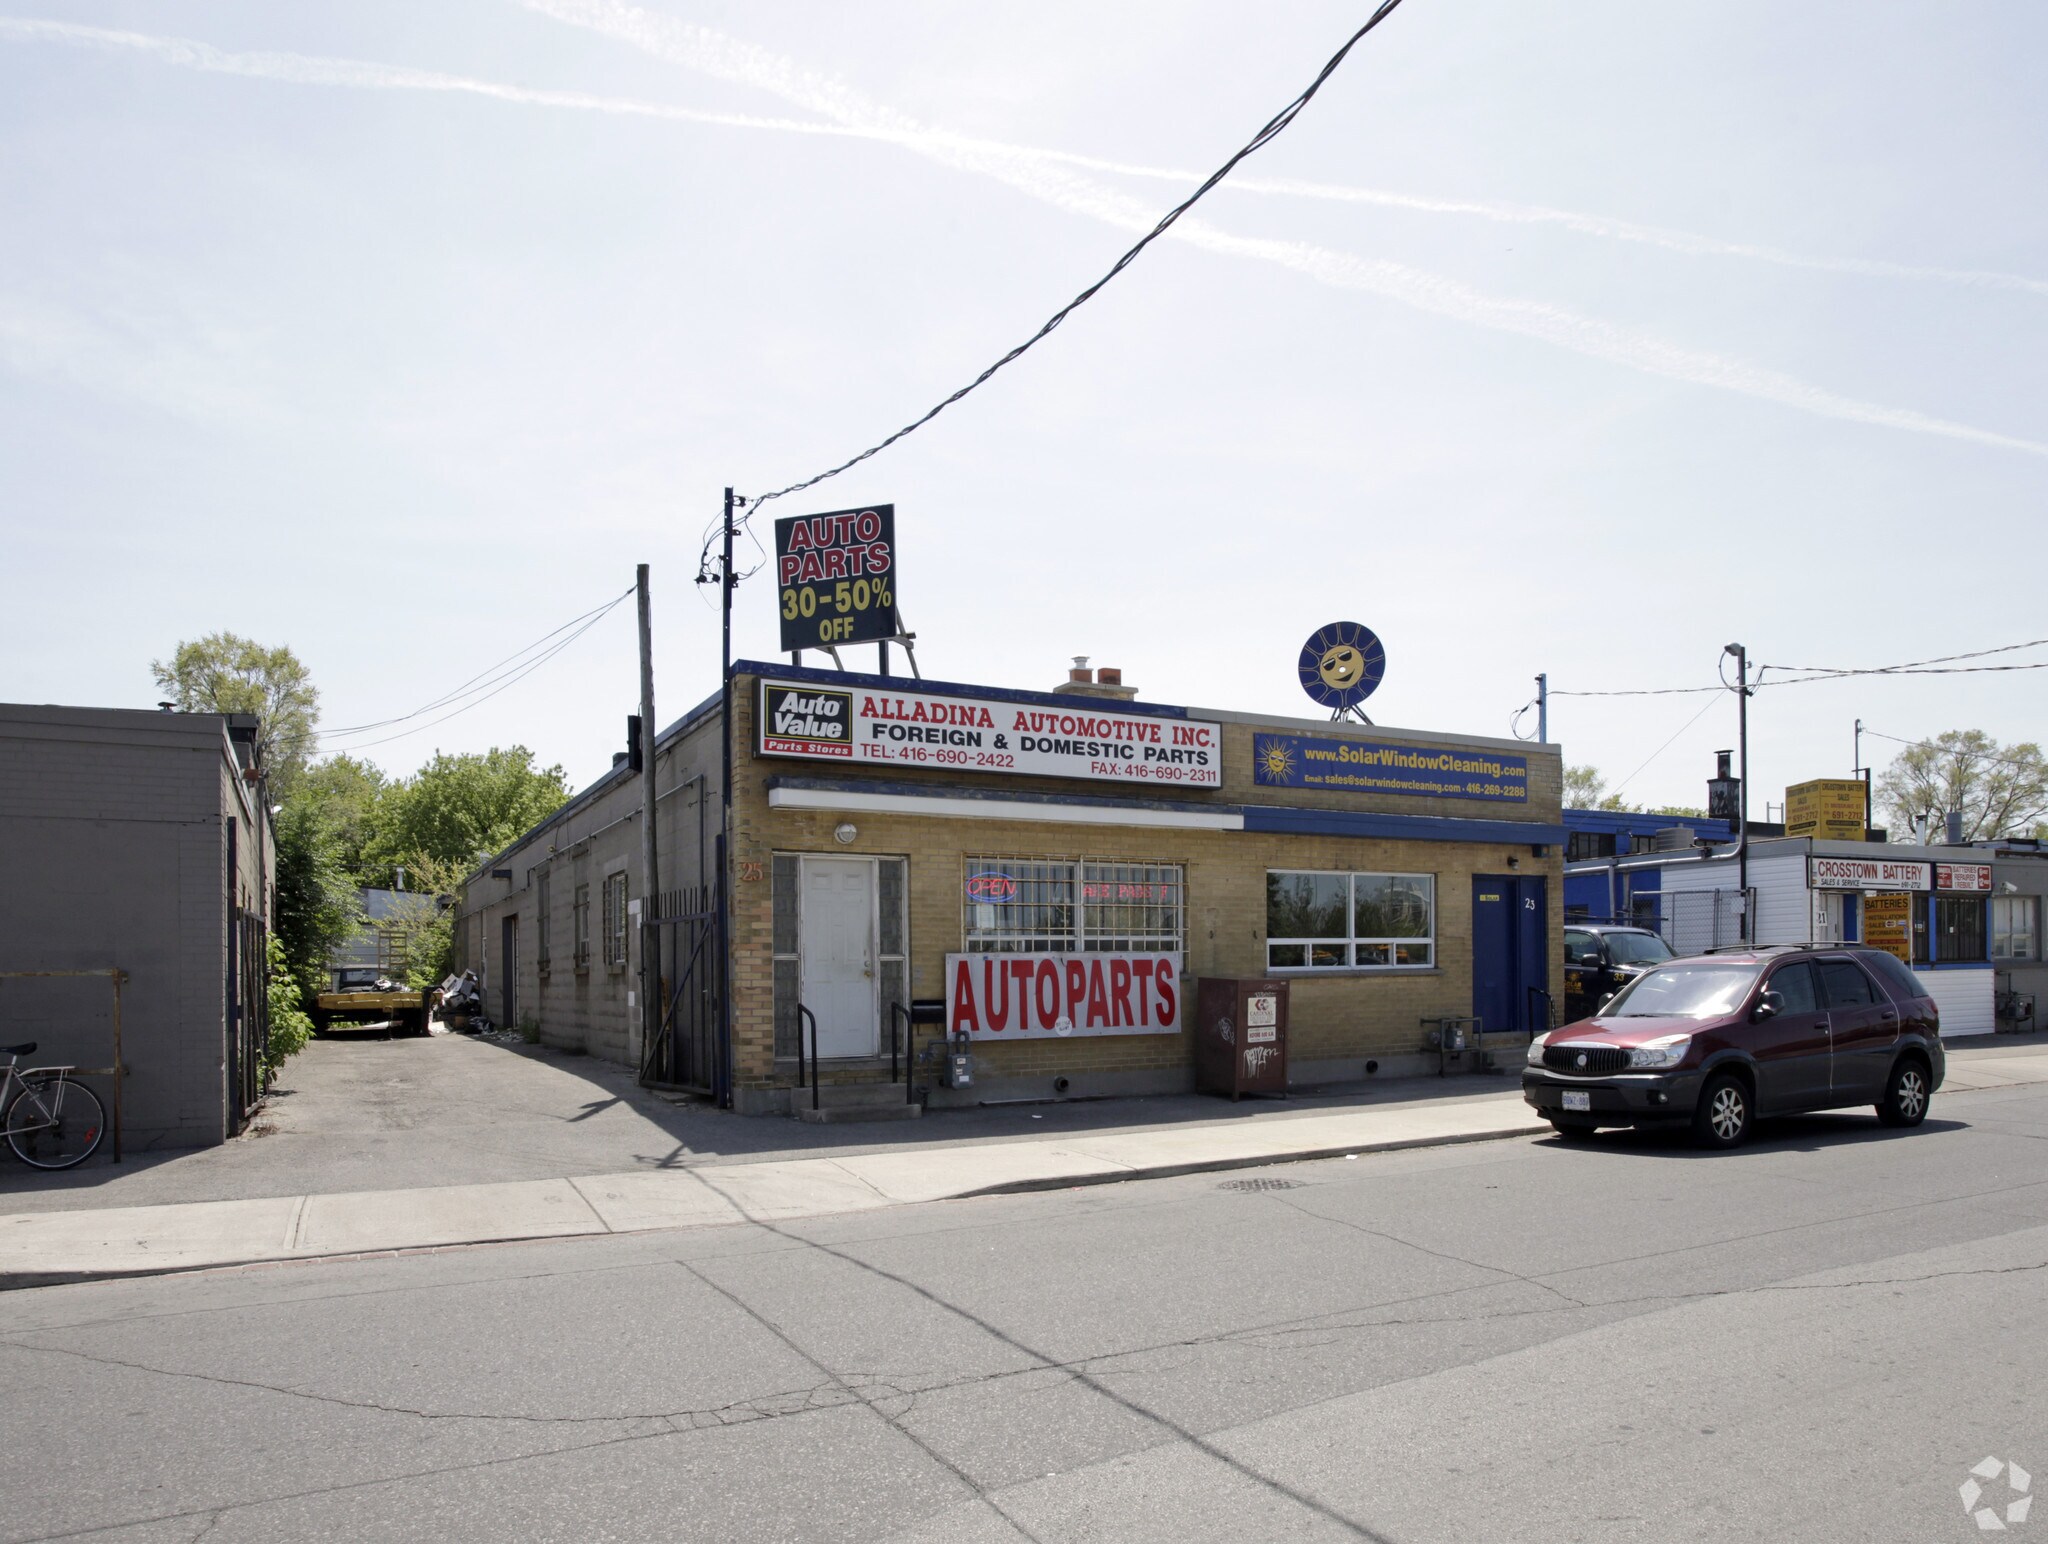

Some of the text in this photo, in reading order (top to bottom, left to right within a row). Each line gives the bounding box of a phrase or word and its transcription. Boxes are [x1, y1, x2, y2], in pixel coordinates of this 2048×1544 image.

[788, 511, 881, 552] AUTO
[780, 542, 890, 586] PARTS
[783, 577, 891, 620] 30-50%
[819, 617, 854, 641] OFF
[778, 692, 840, 716] Auto
[774, 712, 842, 738] Value
[860, 696, 1215, 748] ALLADINA AUTOMOTIVE INC.
[768, 740, 848, 755] Parts Stores
[860, 743, 1014, 768] TEL: 416-690-2422
[872, 723, 1208, 765] FOREIGN & DOMESTIC PARTS
[1091, 762, 1216, 782] FAX: 416-690-2311
[1304, 745, 1525, 778] www.SolarWindowCleaning.com
[1325, 774, 1460, 793] sales@solarwindowcleaning.com
[1466, 782, 1525, 798] 416-269-2288
[1832, 811, 1862, 820] 691-2712
[741, 862, 764, 881] 25
[1818, 861, 1878, 879] CROSSTOWN
[1883, 865, 1922, 880] BATTERY
[1821, 878, 1835, 886] SALES
[967, 878, 1016, 895] OPEN
[1864, 898, 1908, 909] BATTERIES
[1614, 973, 1625, 982] 33
